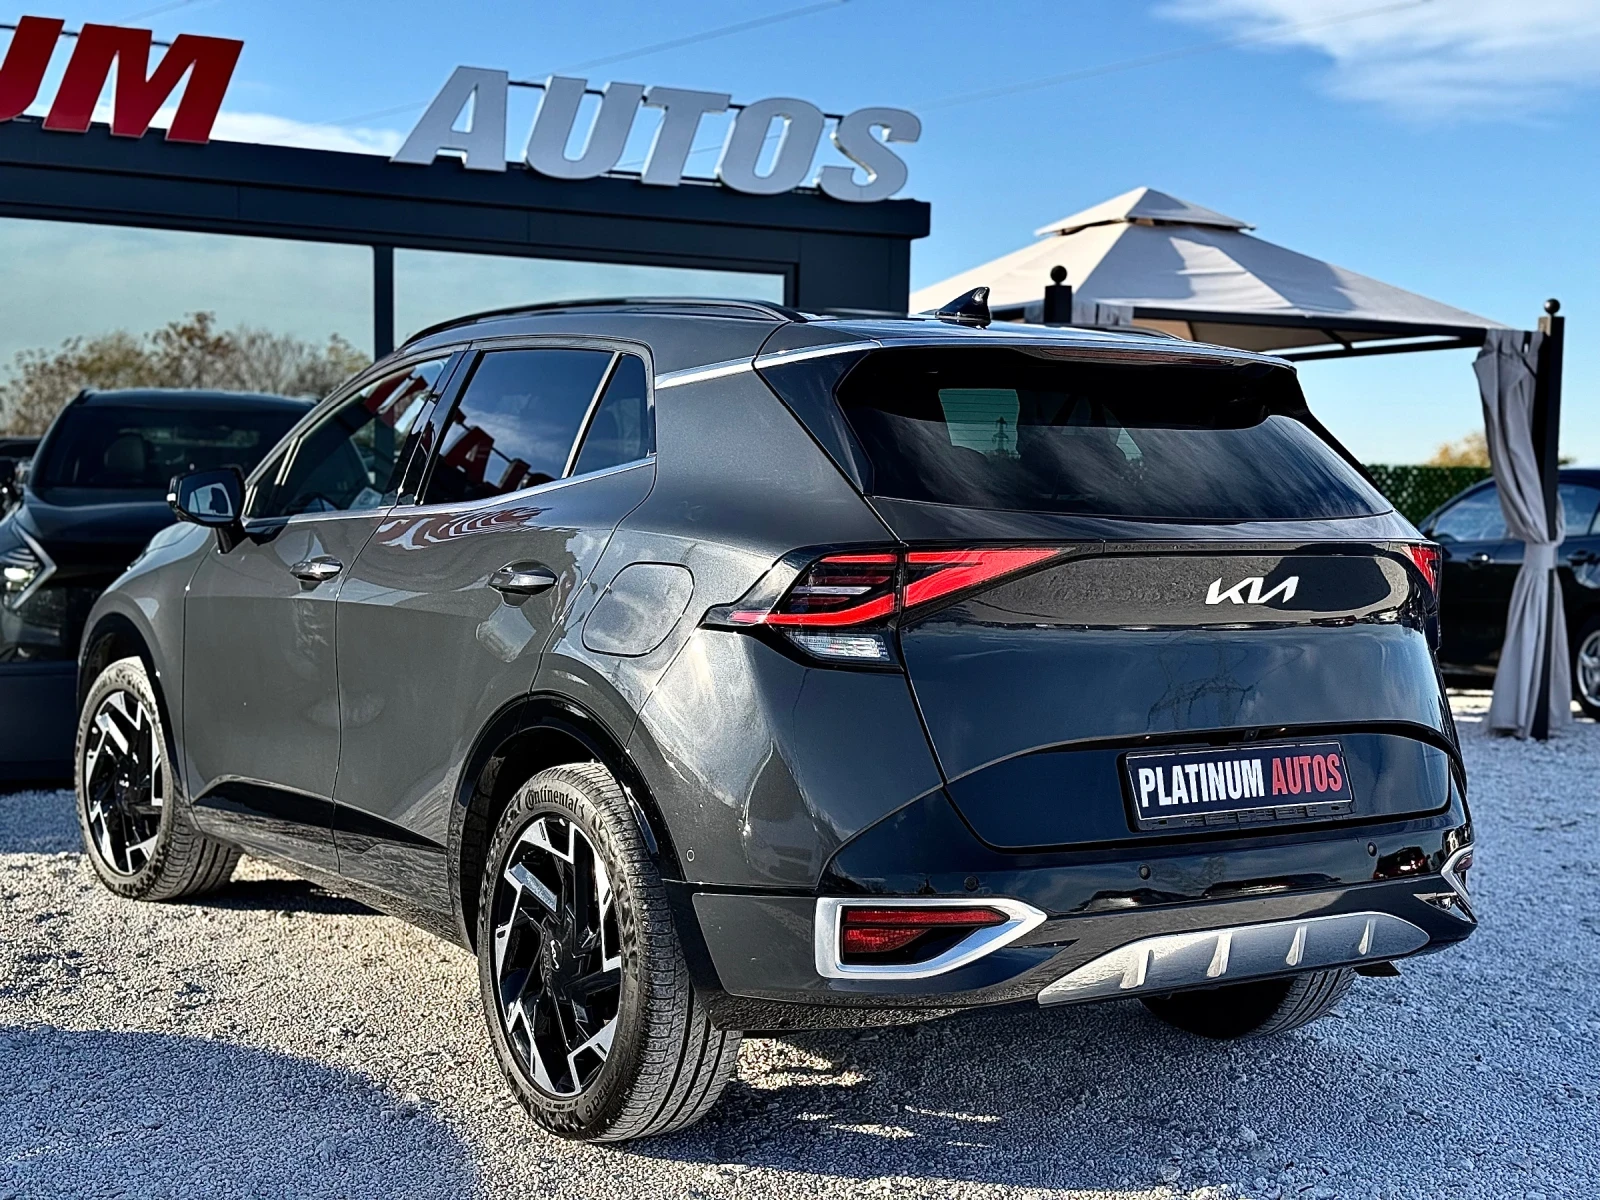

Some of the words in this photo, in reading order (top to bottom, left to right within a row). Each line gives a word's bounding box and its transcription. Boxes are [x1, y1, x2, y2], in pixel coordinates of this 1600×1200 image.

[390, 65, 922, 202] AUTOS
[1205, 576, 1299, 605] KIA
[525, 785, 579, 814] Continental
[1138, 759, 1265, 808] PLATINUM
[1272, 753, 1343, 796] AUTOS
